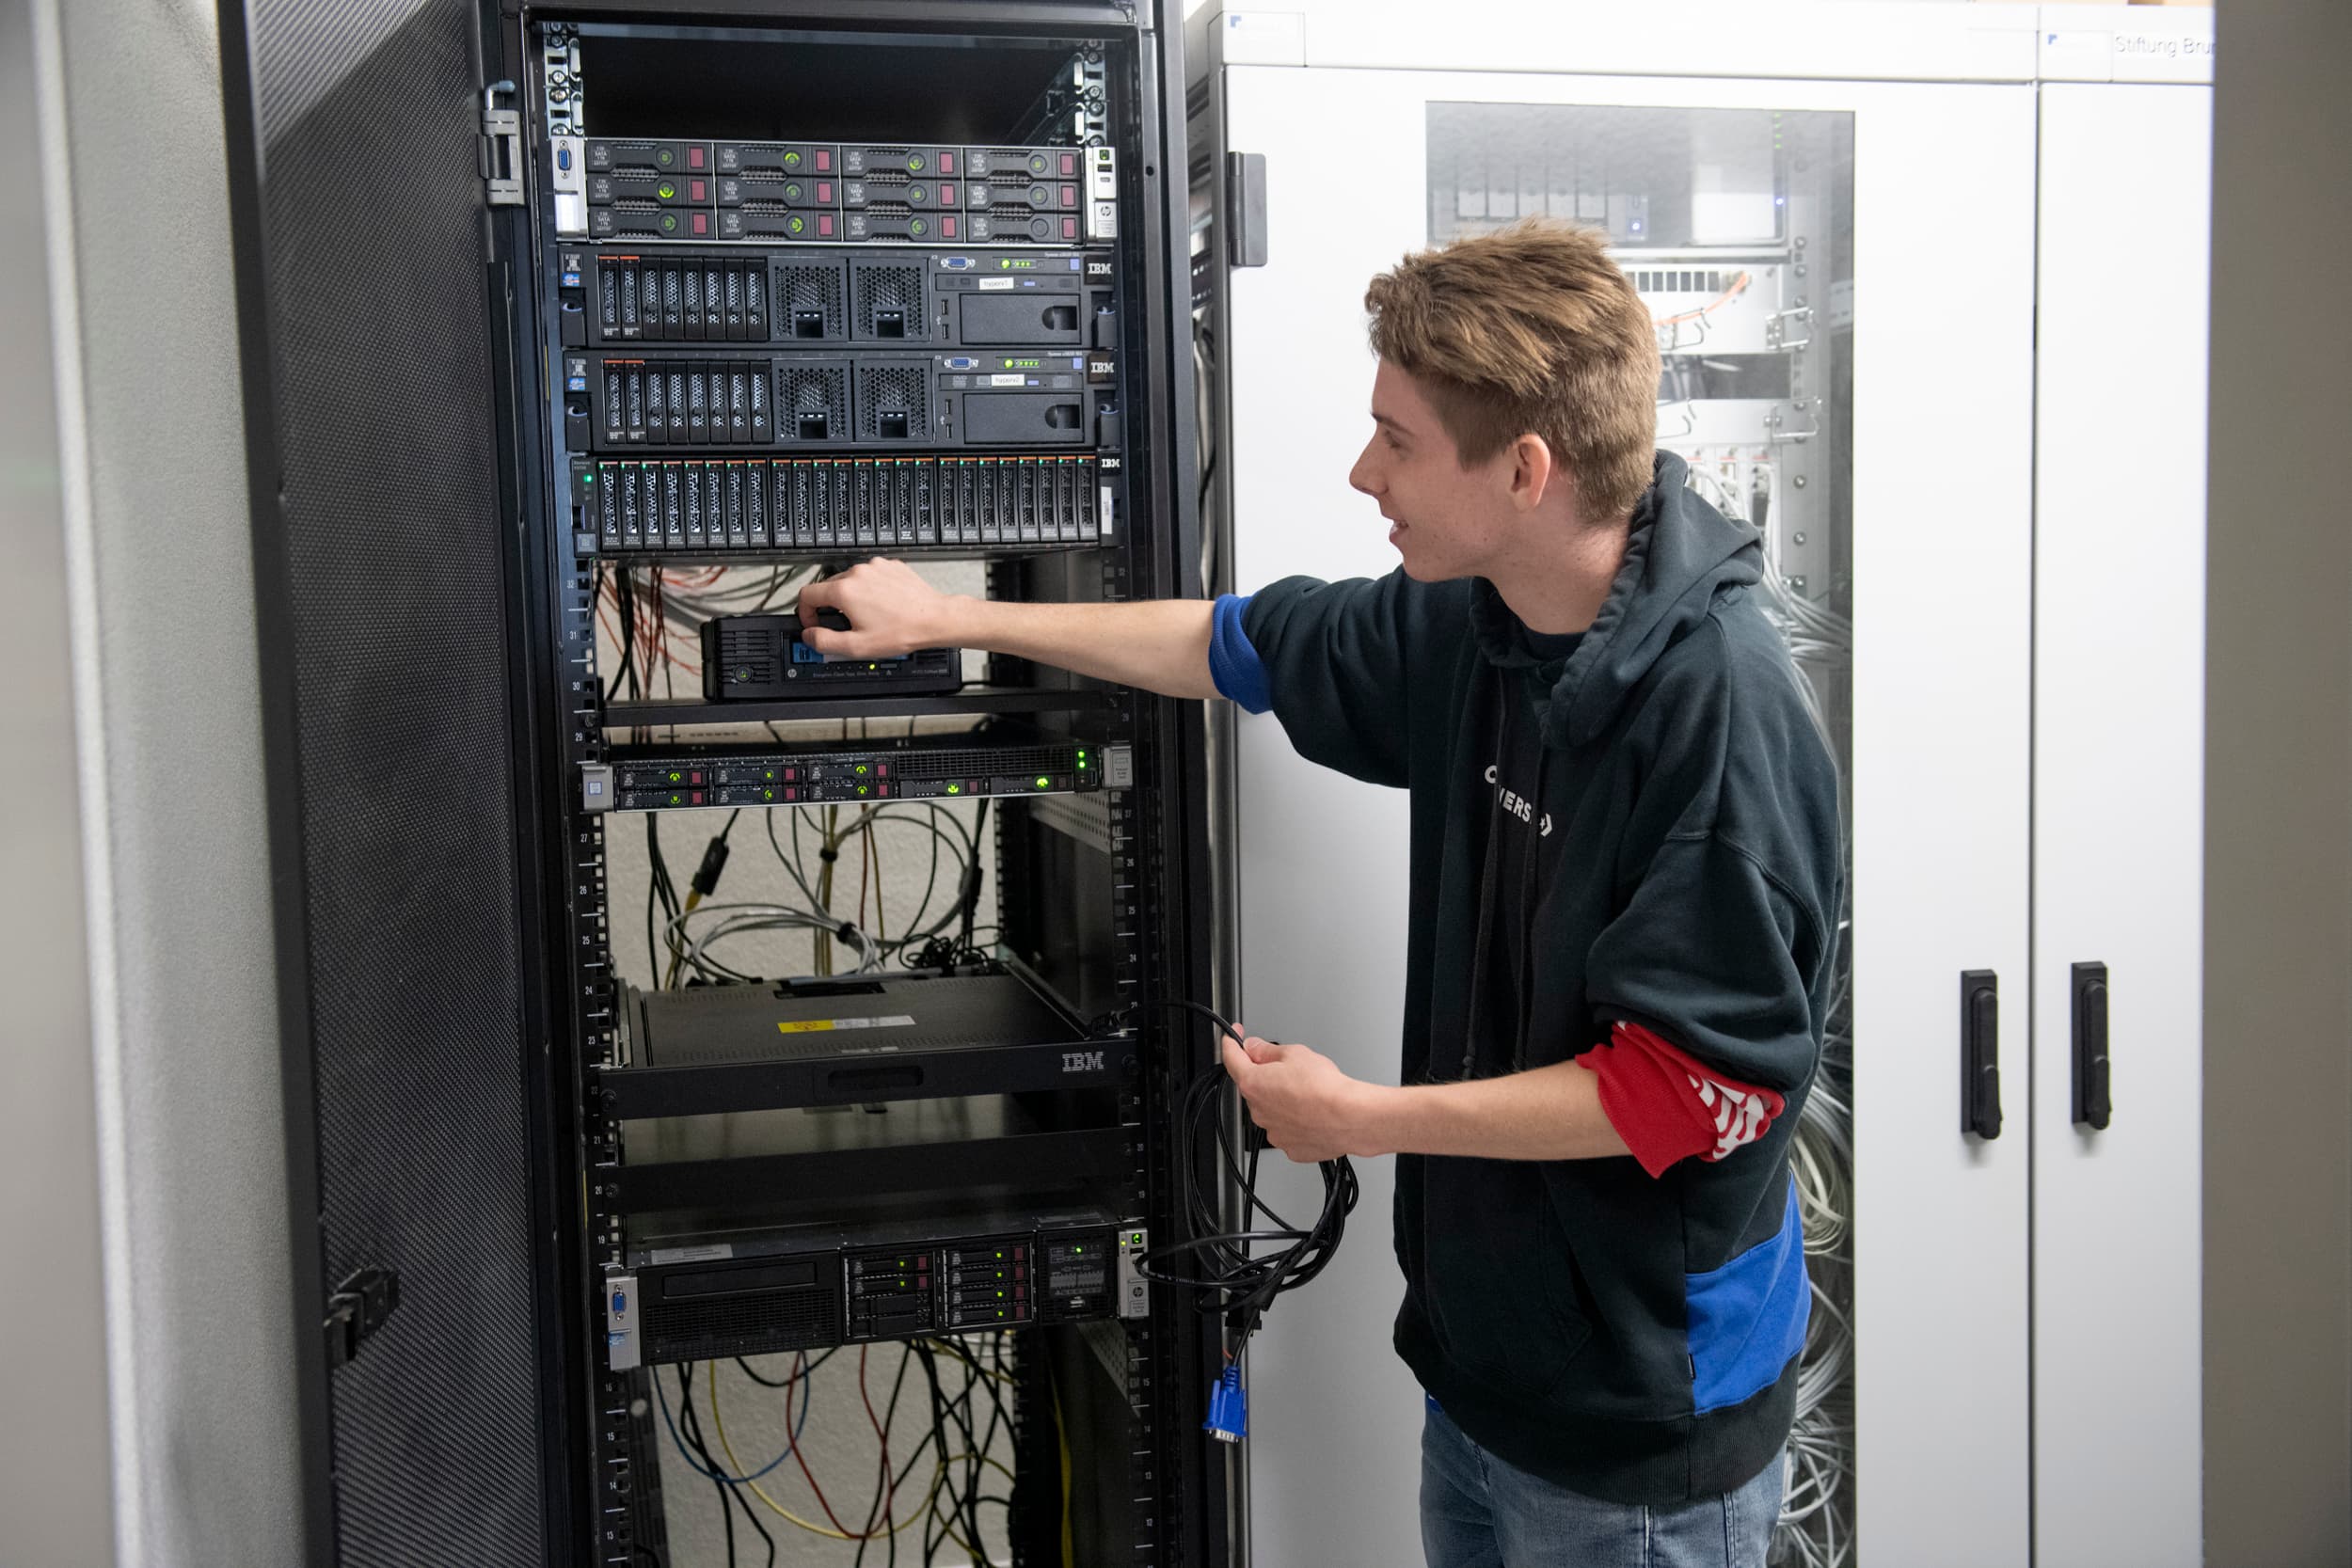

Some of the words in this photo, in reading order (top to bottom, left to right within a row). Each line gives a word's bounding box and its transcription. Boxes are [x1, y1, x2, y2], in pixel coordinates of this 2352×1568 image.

[2115, 36, 2177, 58] Stiftung
[2184, 38, 2216, 55] Bru
[1088, 262, 1112, 275] IBM
[1090, 361, 1115, 373] IBM
[1101, 458, 1120, 467] IBM
[567, 579, 574, 589] 32
[570, 631, 576, 640] 31
[573, 682, 580, 690] 30
[576, 733, 582, 741] 29
[580, 833, 587, 842] 27
[580, 886, 587, 895] 26
[582, 936, 590, 944] 25
[585, 986, 592, 994] 24
[588, 1037, 596, 1045] 23
[1062, 1052, 1104, 1072] IBM
[596, 1186, 602, 1195] 20
[598, 1235, 605, 1243] 19
